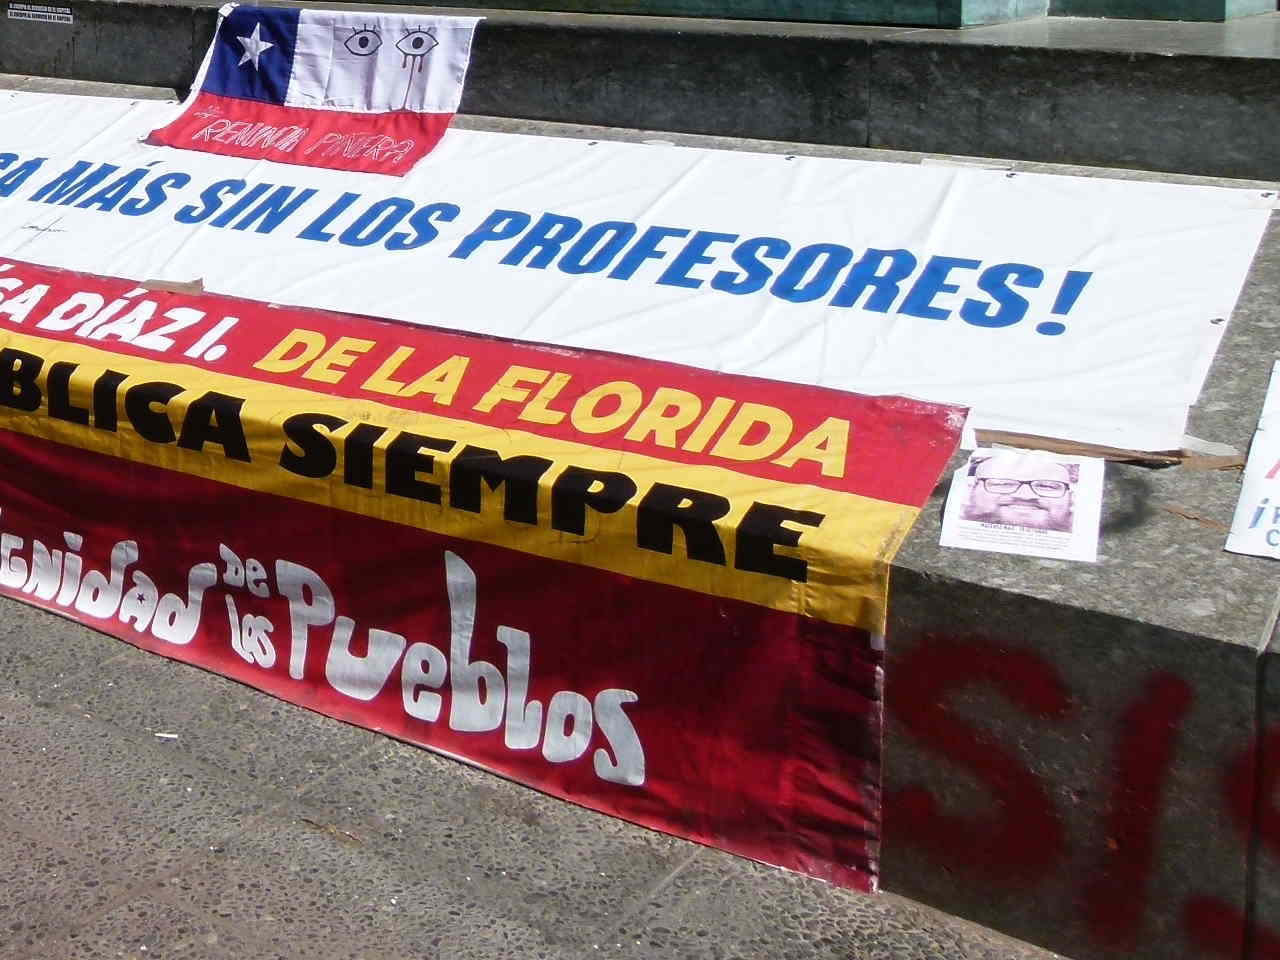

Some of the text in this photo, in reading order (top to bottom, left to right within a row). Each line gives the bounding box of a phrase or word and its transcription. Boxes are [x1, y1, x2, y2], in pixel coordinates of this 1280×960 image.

[28, 160, 191, 216] MÁS
[174, 178, 318, 235] SIN
[296, 192, 461, 251] LOS
[448, 208, 1093, 336] PROFESORES!
[37, 287, 207, 354] DÍAZ
[188, 316, 240, 362] I.
[252, 328, 377, 384] DE
[360, 345, 471, 406] LA
[472, 365, 851, 479] FLORIDA
[279, 412, 826, 583] SIEMPRE
